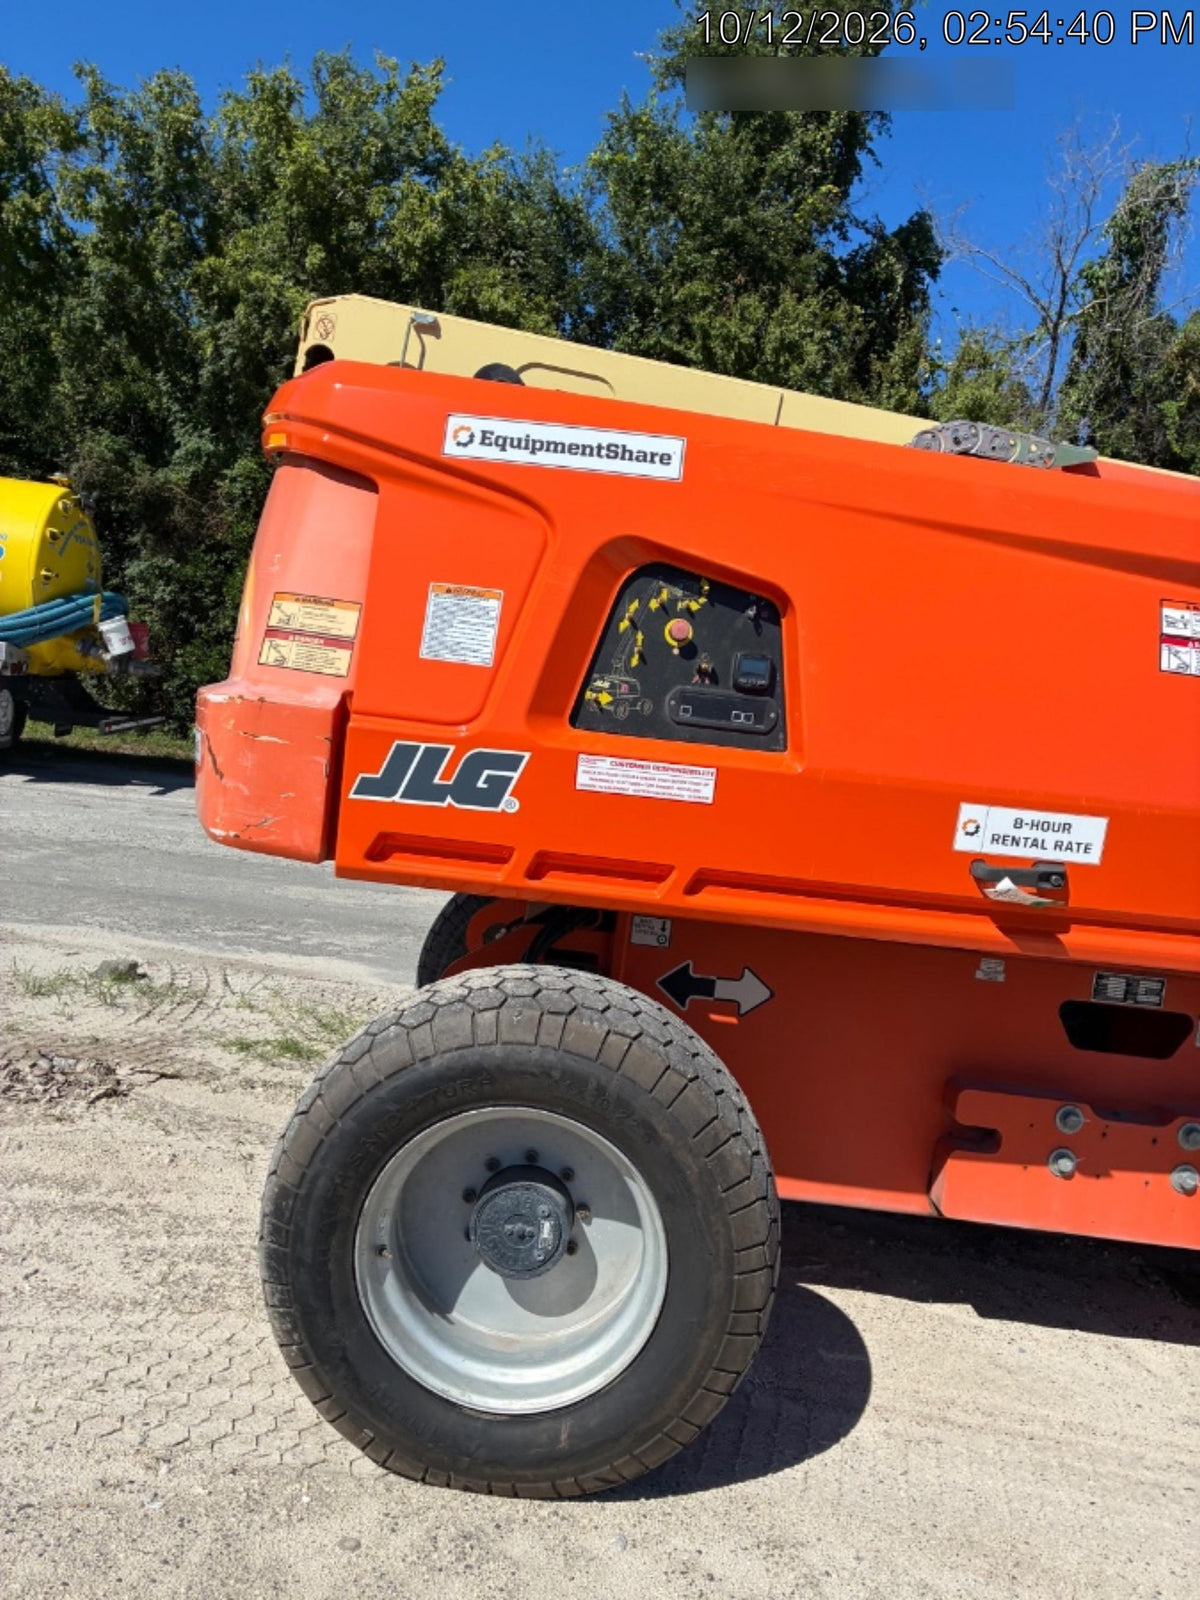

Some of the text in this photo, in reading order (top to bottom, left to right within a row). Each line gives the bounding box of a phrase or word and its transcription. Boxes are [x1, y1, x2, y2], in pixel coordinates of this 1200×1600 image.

[478, 429, 672, 466] EquipmentShare
[349, 740, 531, 812] JLG
[1013, 817, 1072, 834] 8-HOUR
[990, 833, 1094, 855] RENTAL RATE
